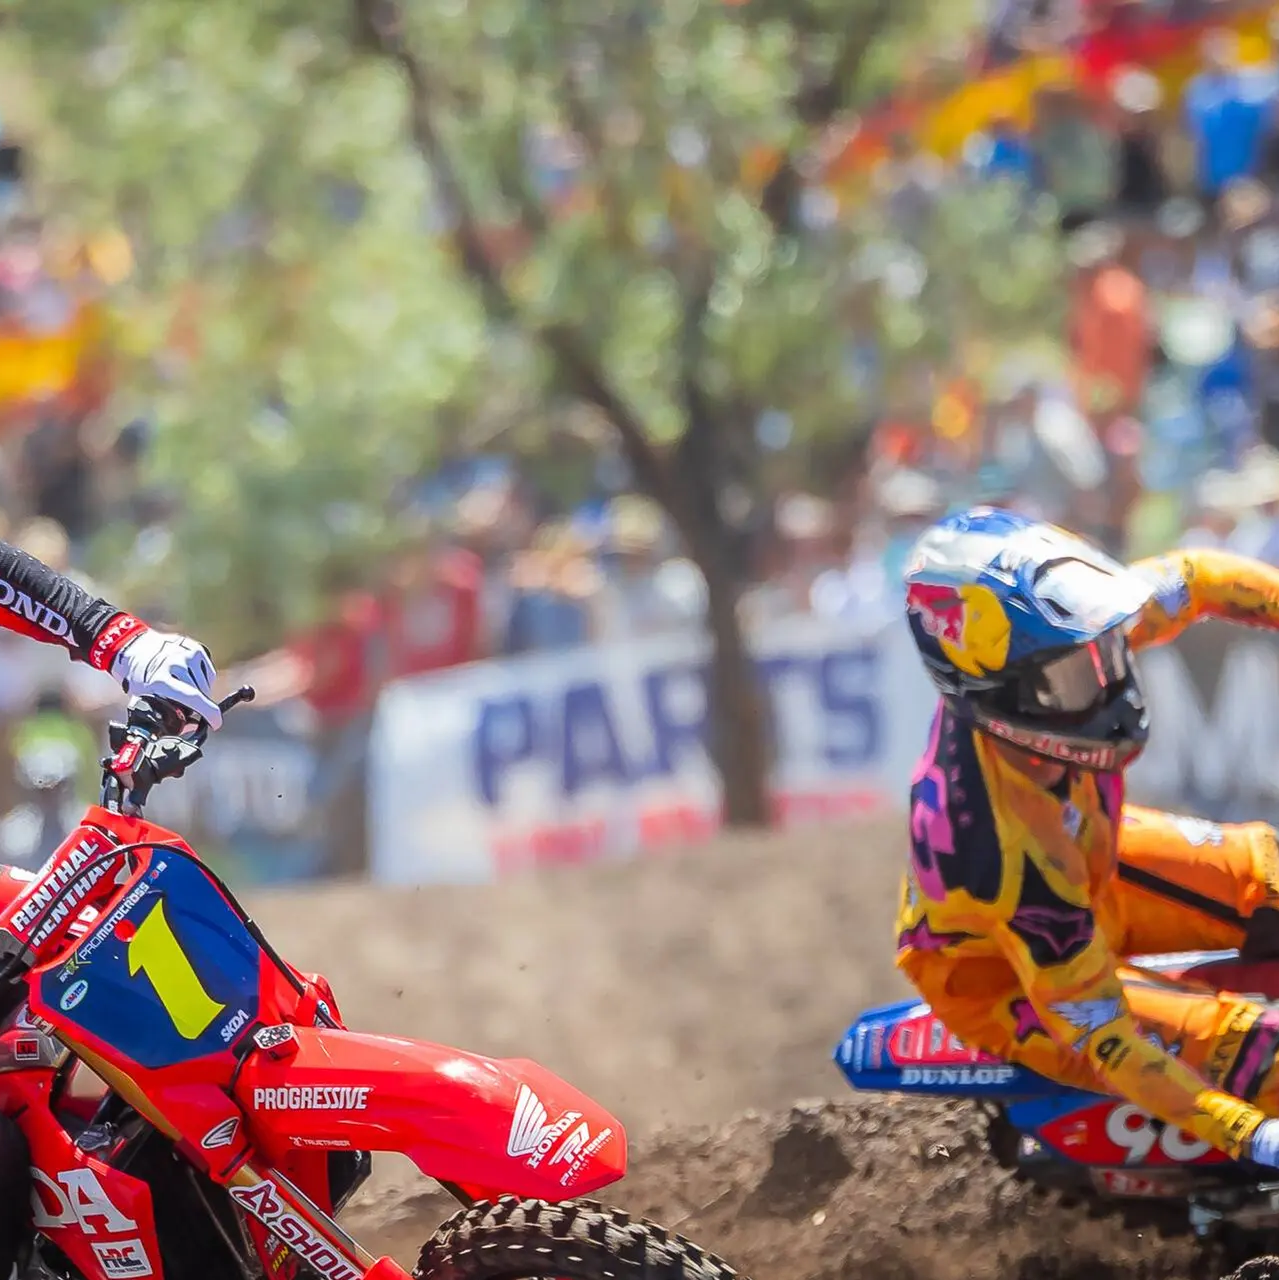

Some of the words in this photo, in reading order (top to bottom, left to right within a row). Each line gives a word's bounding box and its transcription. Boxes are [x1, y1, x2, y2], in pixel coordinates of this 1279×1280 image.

[10, 838, 99, 932] RENTHAL
[128, 898, 226, 1039] 1
[900, 1067, 1014, 1086] DUNLOP
[253, 1087, 370, 1110] PROGRESSIVE
[527, 1111, 583, 1169] HONDA
[97, 1247, 143, 1269] HRC
